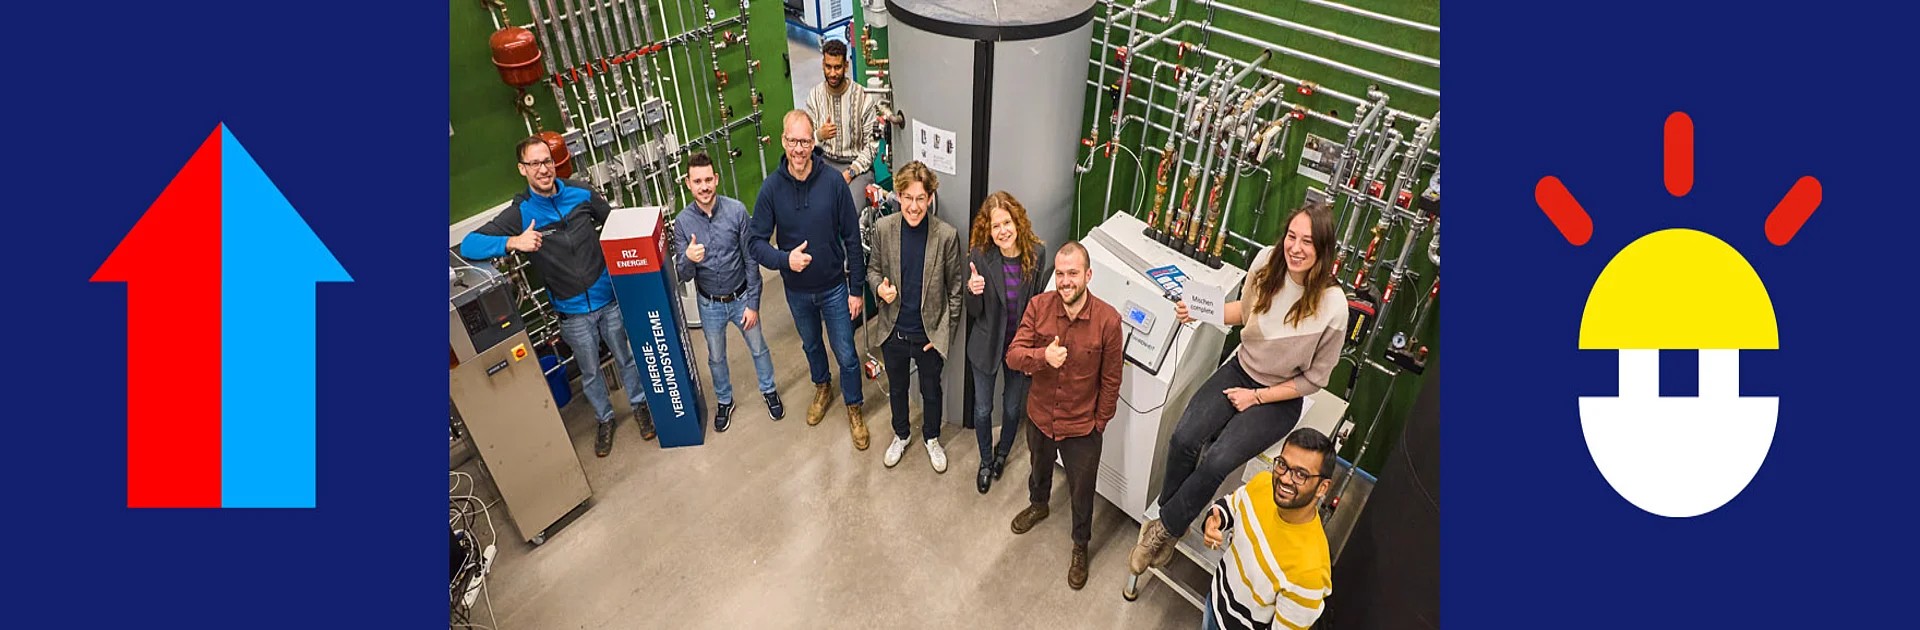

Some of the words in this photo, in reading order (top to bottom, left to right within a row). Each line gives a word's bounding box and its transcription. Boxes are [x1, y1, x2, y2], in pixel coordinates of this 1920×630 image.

[616, 259, 648, 268] ENERGIE
[621, 249, 638, 259] RIZ
[642, 341, 664, 394] ENERGIE-
[648, 310, 685, 418] VERBUNDSYSTEME
